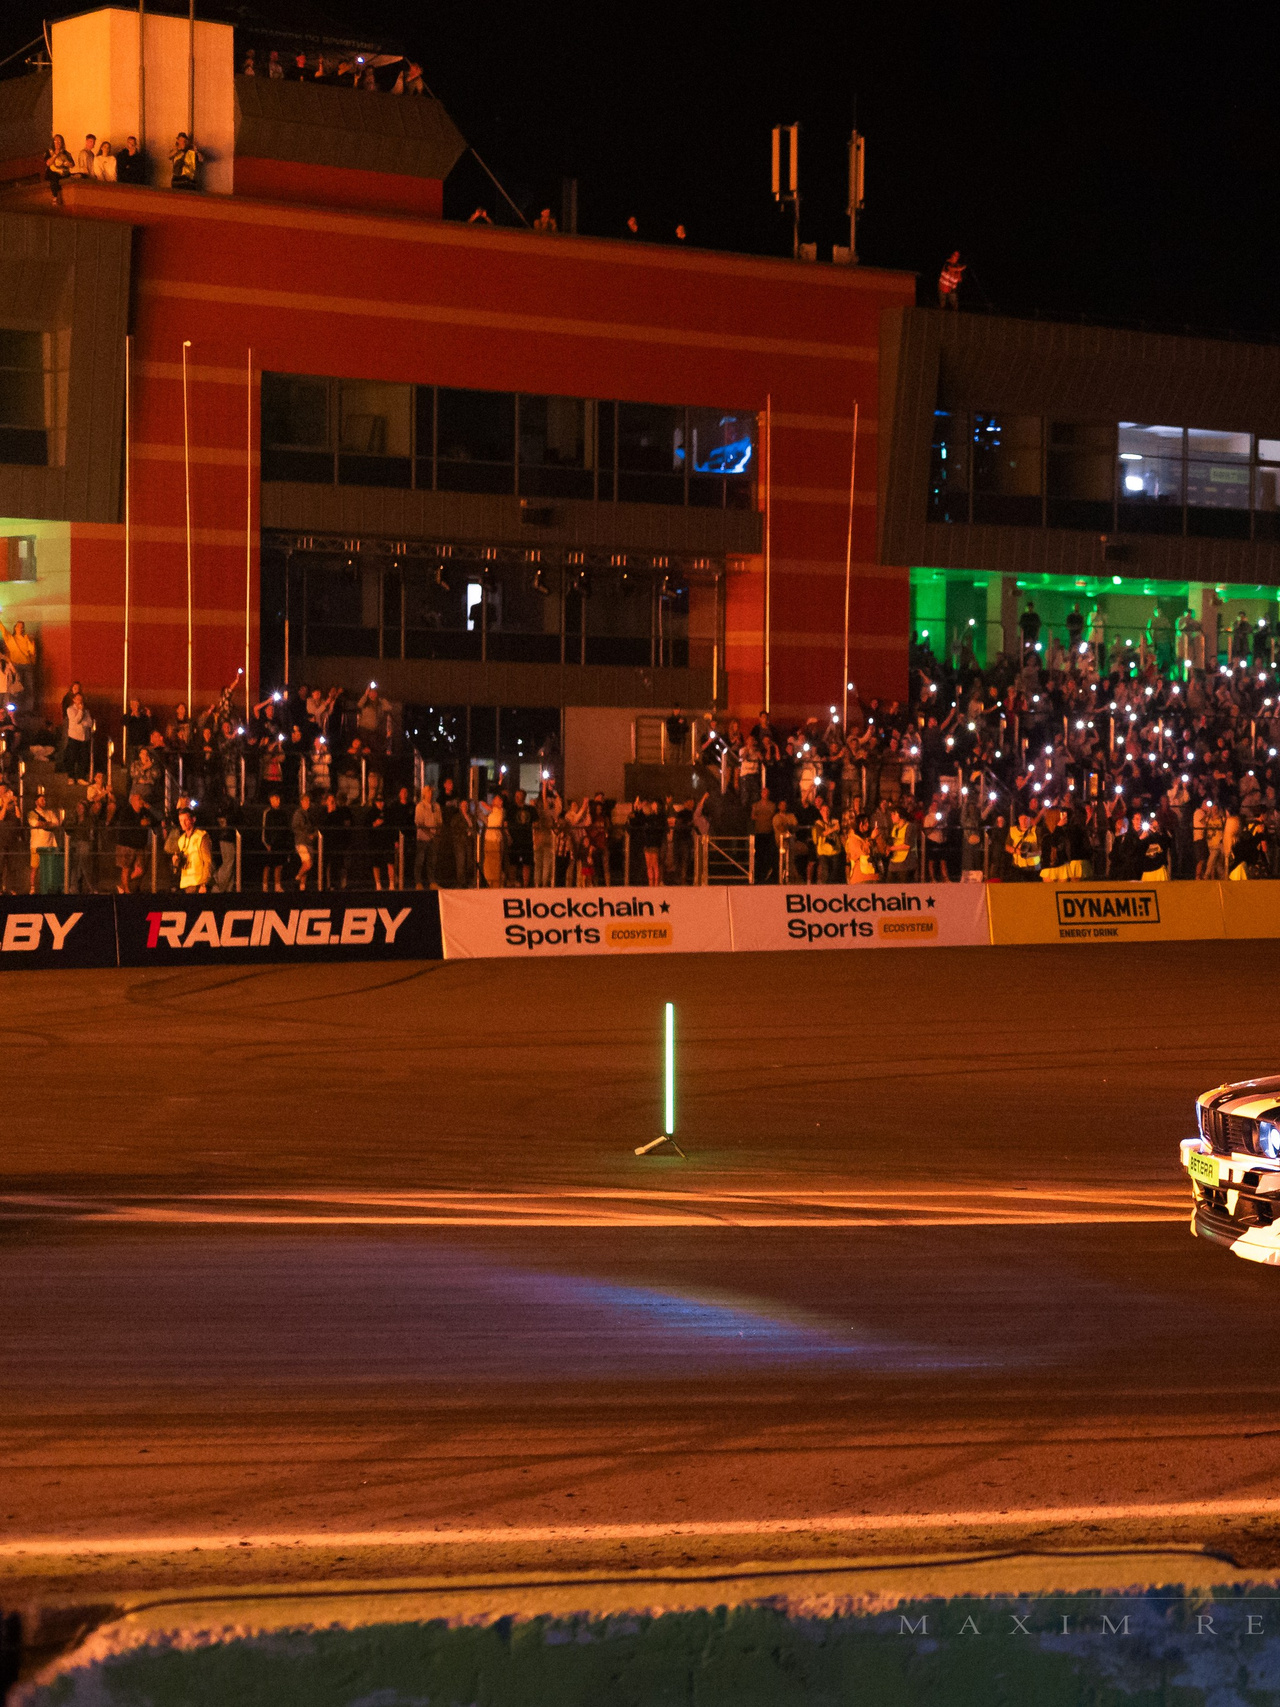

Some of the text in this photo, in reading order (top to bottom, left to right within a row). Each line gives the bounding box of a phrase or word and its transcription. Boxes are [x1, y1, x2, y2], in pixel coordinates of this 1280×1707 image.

[502, 896, 655, 919] Blockchain
[785, 892, 922, 914] Blockchain
[144, 907, 412, 948] 1RACING.BY
[504, 924, 668, 950] Sports ECOSYSTEM
[787, 918, 934, 943] Sports ECOSYSTEM
[1059, 928, 1119, 938] ENERGY DRINK
